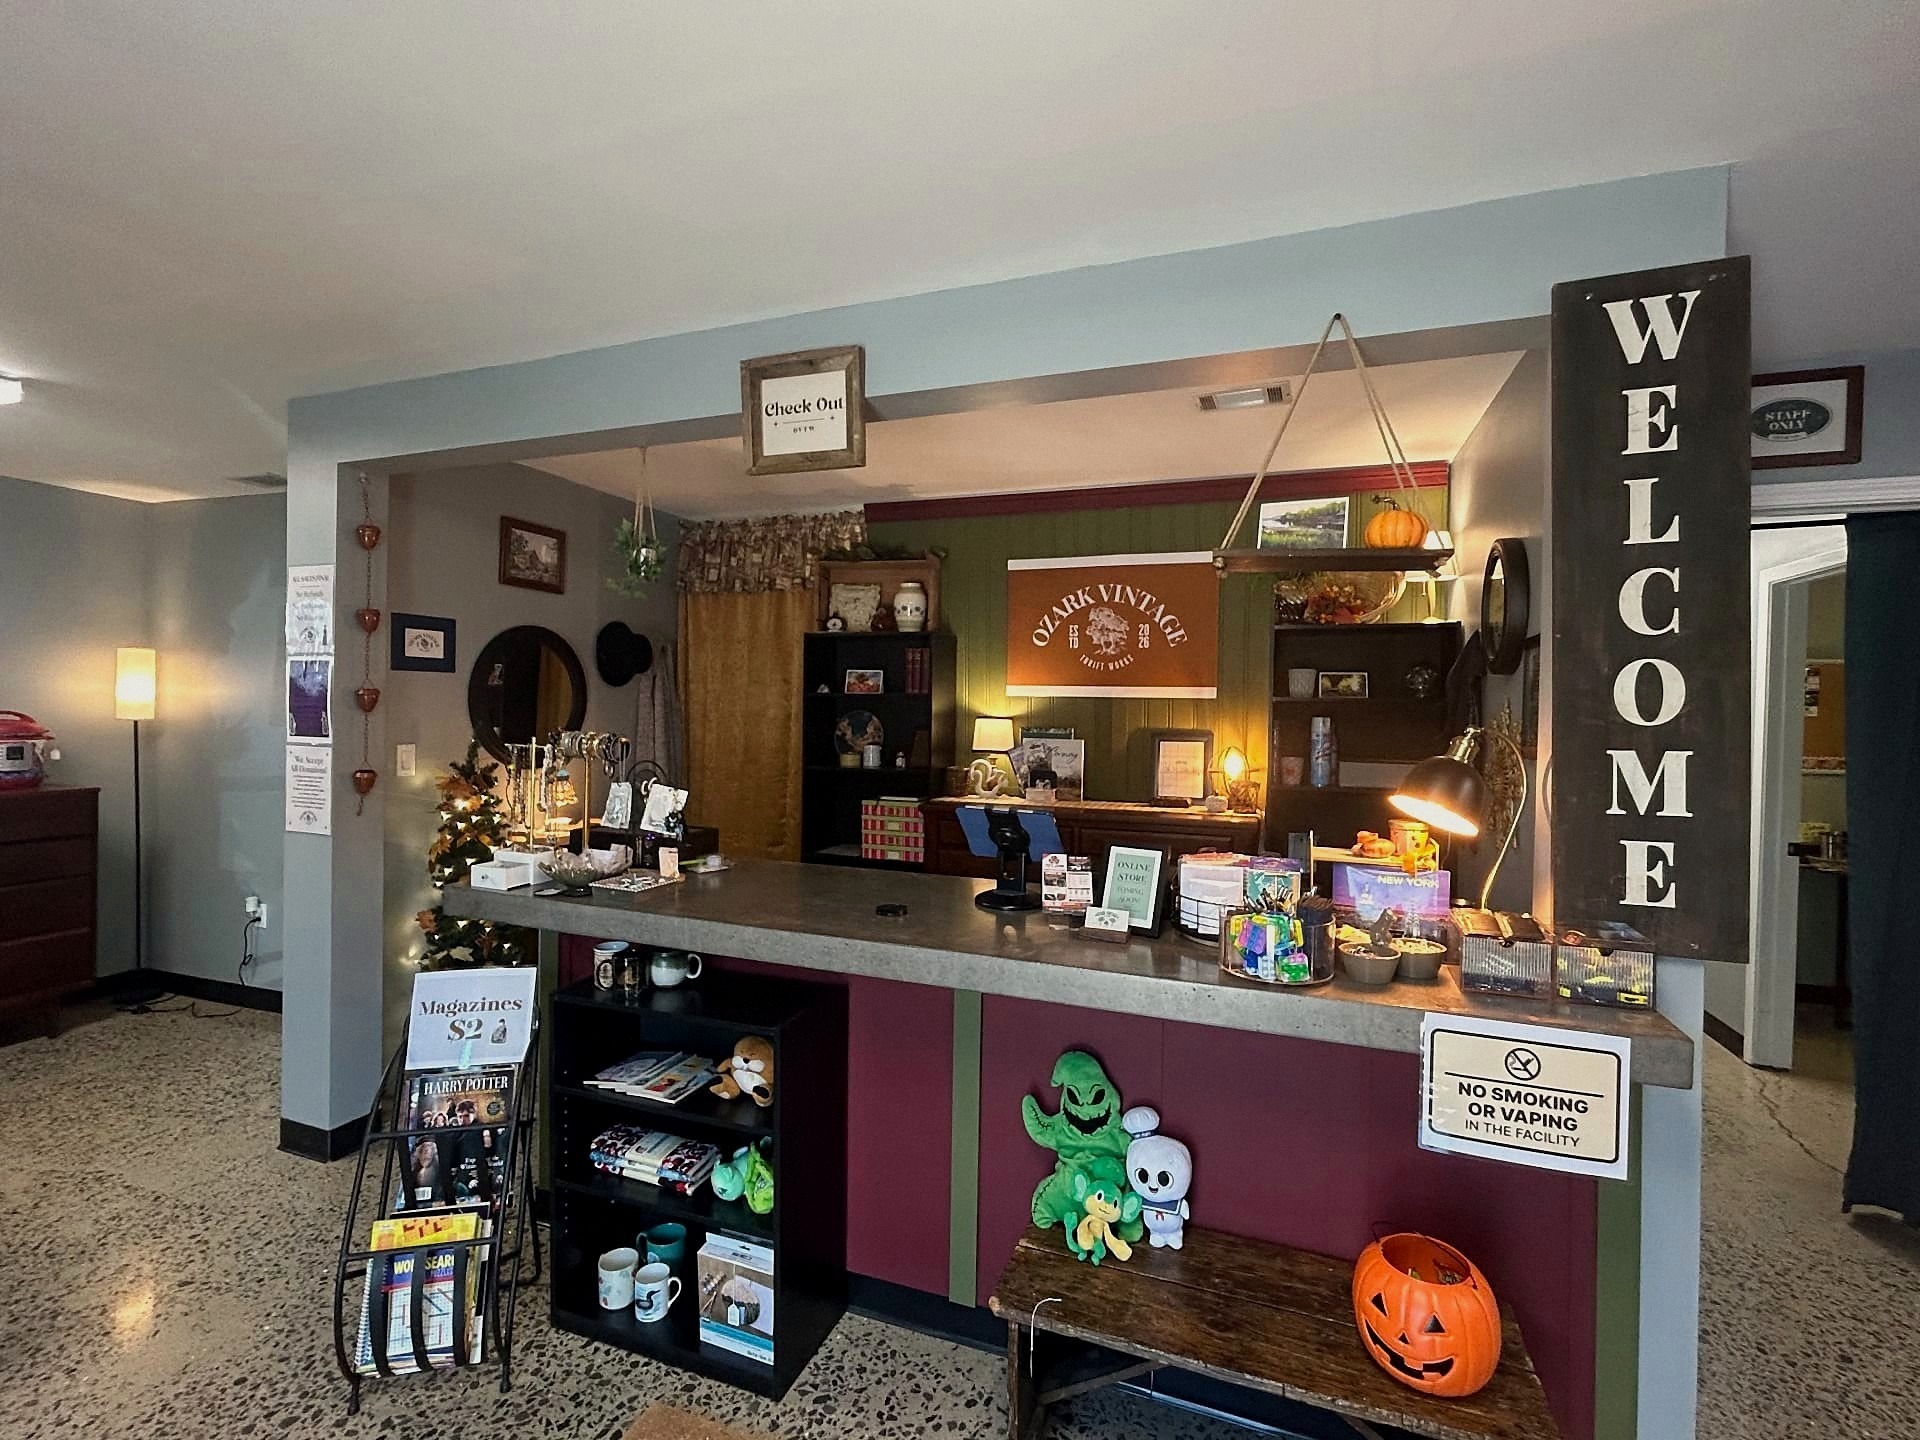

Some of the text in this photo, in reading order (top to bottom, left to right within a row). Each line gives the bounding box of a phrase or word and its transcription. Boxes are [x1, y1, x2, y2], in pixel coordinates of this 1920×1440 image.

[765, 397, 843, 417] Check Out
[1765, 409, 1812, 421] STAFF
[1769, 419, 1806, 431] ONLY
[1602, 290, 1701, 909] WELCOME
[1032, 584, 1188, 648] OZARK VINTAGE
[1069, 624, 1079, 637] ES
[1069, 637, 1079, 649] TD
[1080, 653, 1134, 671] THRIFT WORKS
[1117, 862, 1151, 873] ONLINE
[1117, 873, 1147, 884] STORE
[1377, 875, 1439, 888] NEW YORK
[419, 997, 523, 1017] Magazines
[424, 1079, 464, 1095] HARRY
[466, 1076, 508, 1091] POTTER
[1458, 1082, 1589, 1114] NO SMOKING
[1468, 1102, 1578, 1132] OR VAPING
[1465, 1119, 1580, 1147] IN THE FACILITY
